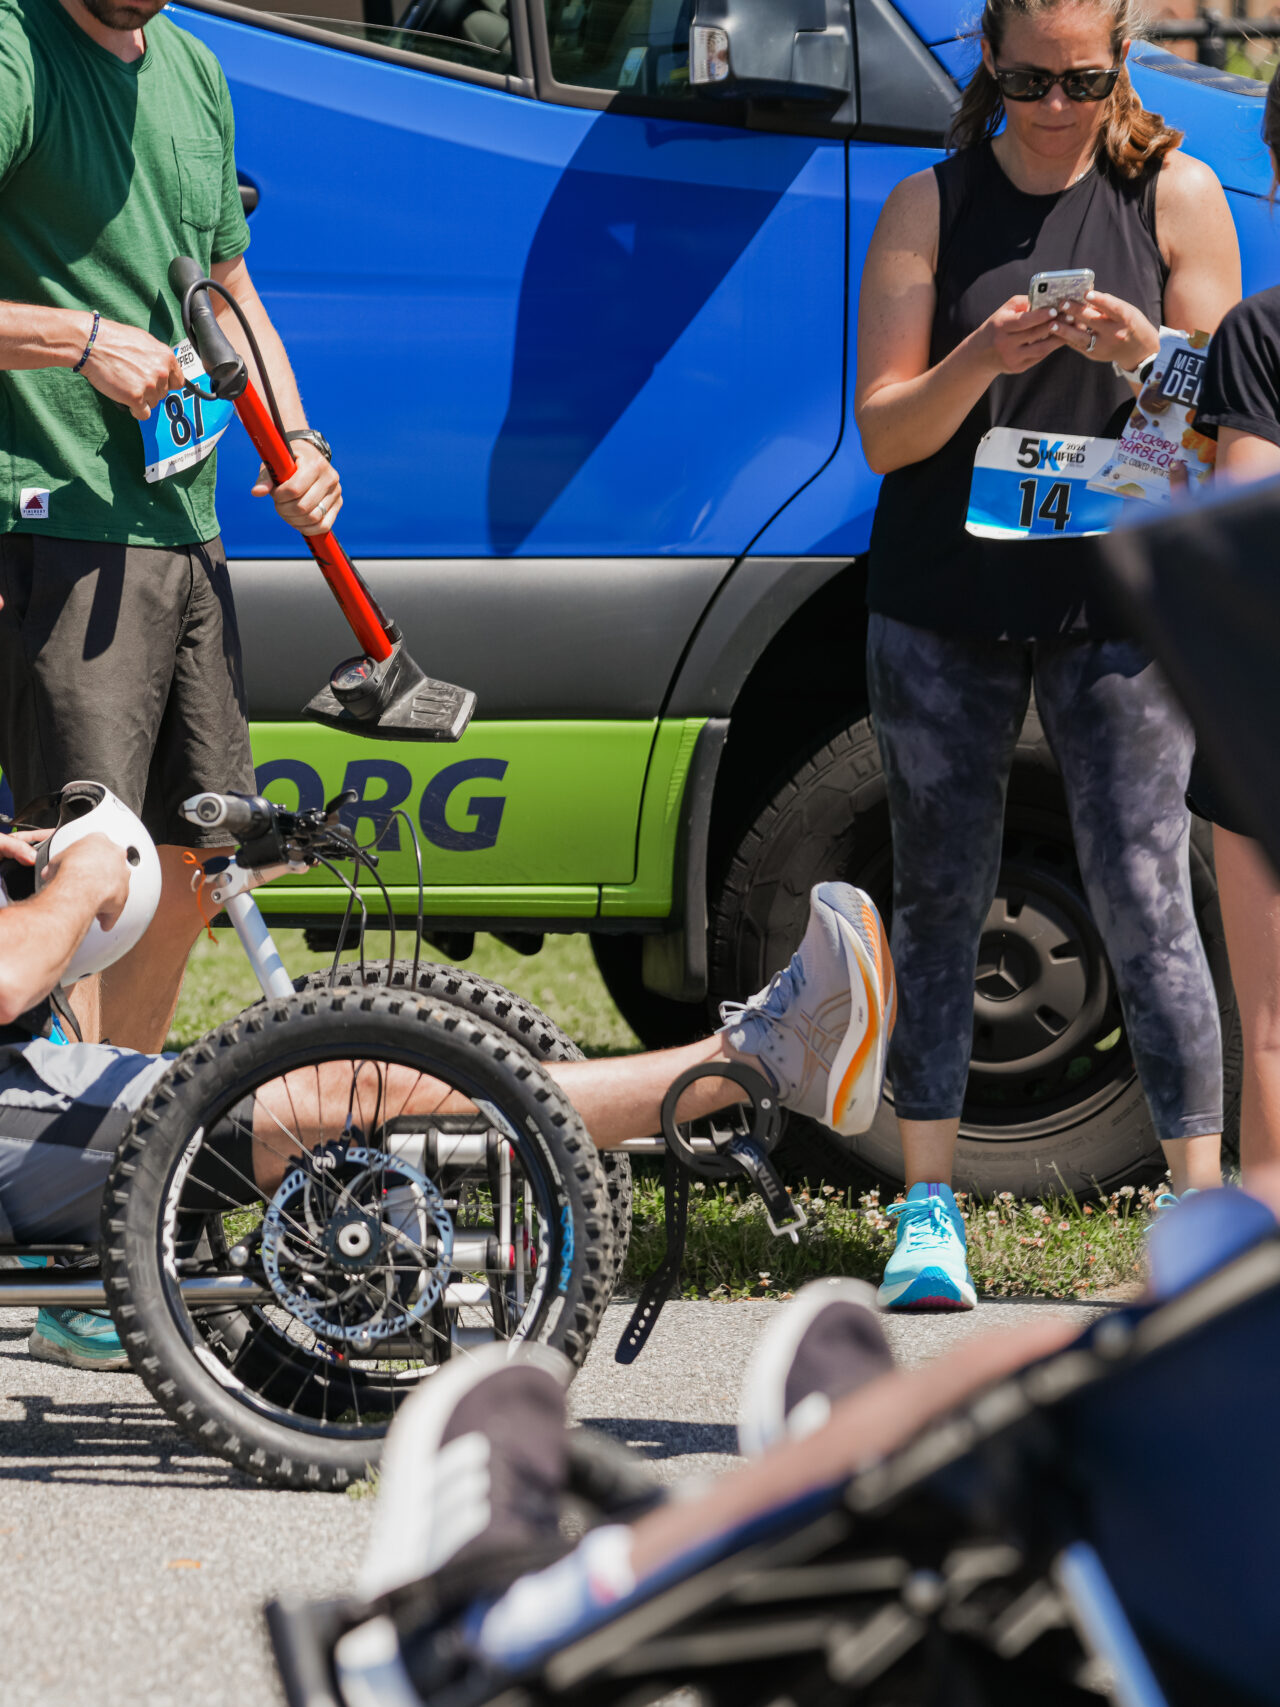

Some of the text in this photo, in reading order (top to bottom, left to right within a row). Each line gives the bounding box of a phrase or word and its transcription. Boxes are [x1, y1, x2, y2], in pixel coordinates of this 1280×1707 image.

[1173, 353, 1205, 375] MET
[1162, 369, 1202, 406] DEL
[164, 382, 204, 447] 87
[1017, 437, 1086, 471] 5K 2024
[1040, 449, 1085, 464] UNIFIED
[1019, 478, 1072, 531] 14
